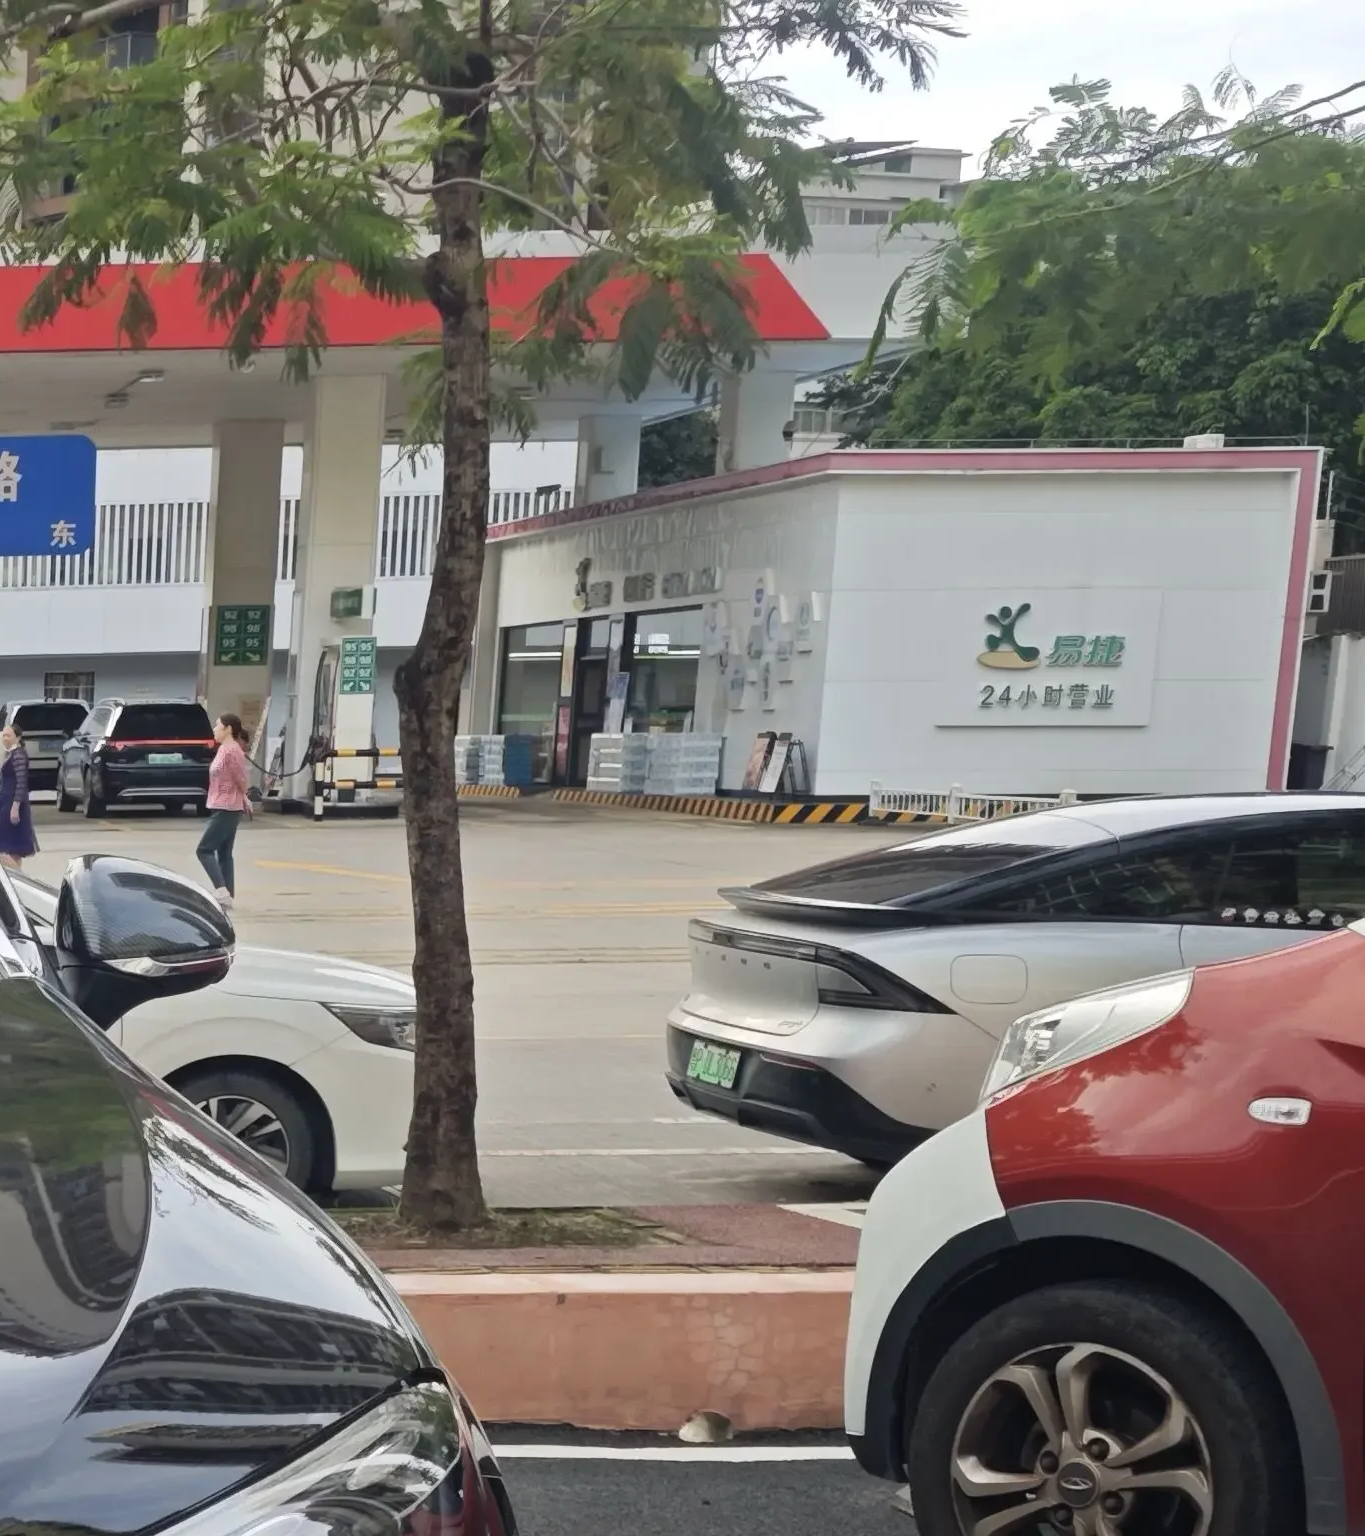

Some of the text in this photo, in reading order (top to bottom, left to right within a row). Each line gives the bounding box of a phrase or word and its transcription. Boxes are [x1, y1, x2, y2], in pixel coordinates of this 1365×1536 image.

[50, 519, 76, 548] 东
[1045, 635, 1126, 668] 易捷
[979, 684, 1115, 709] 24小时营业
